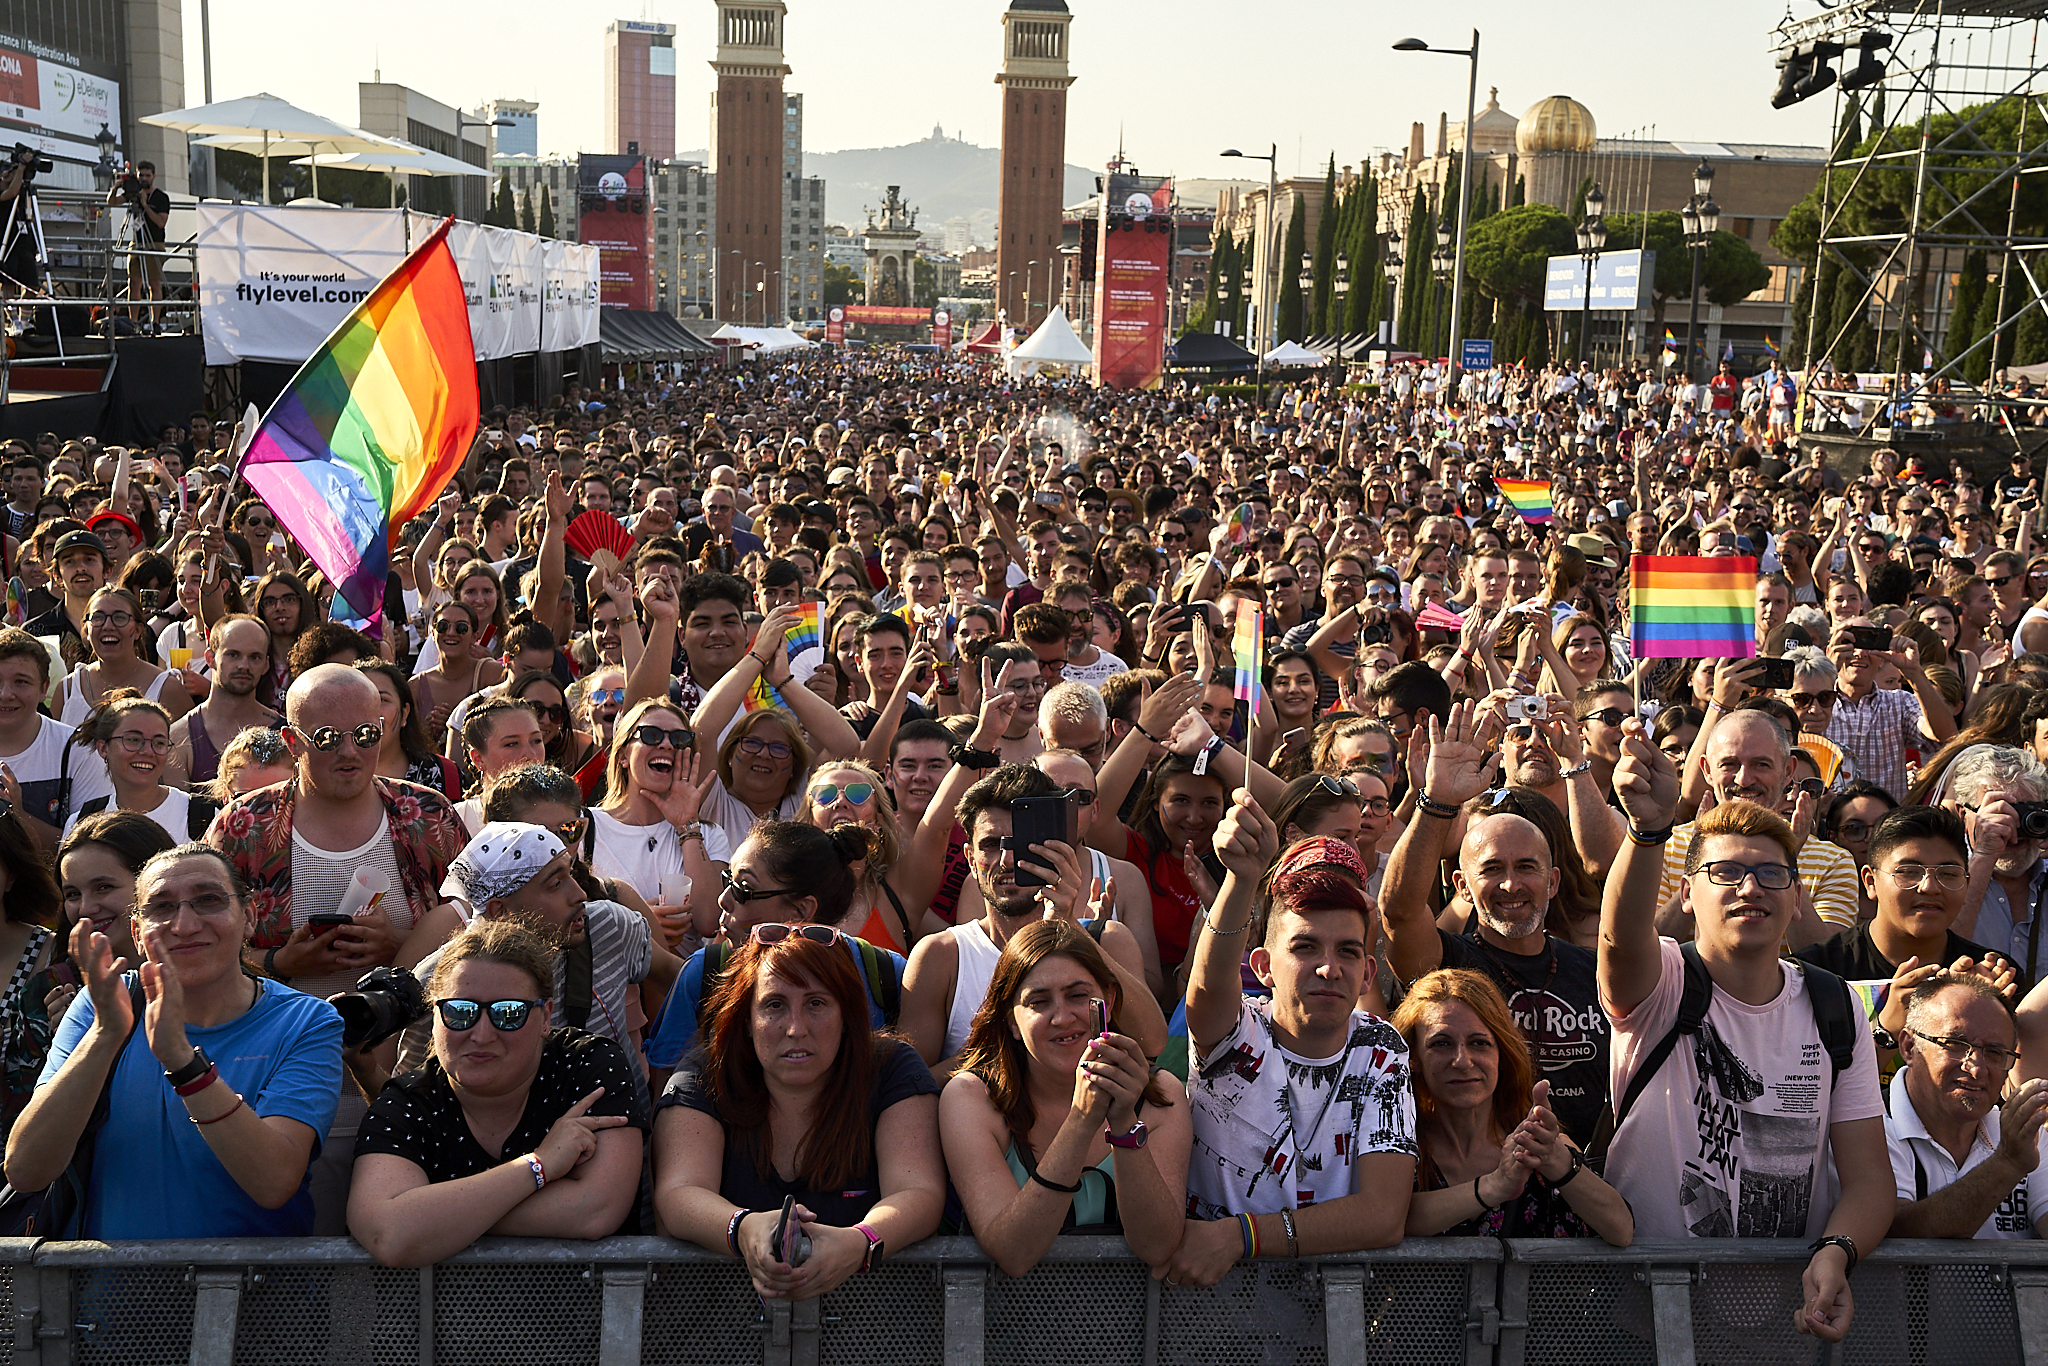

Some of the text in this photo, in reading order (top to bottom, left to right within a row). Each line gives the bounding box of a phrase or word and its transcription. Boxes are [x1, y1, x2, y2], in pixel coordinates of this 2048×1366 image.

[625, 21, 655, 31] Allianz
[28, 40, 65, 60] Registration
[65, 51, 80, 67] Area
[77, 77, 109, 106] eDelivery
[260, 271, 346, 284] It's your world
[236, 283, 369, 305] flylevel.com
[1465, 357, 1489, 366] TAXI
[356, 978, 372, 990] Nikon
[1543, 1005, 1605, 1038] Rock
[1550, 1046, 1591, 1057] CASINO
[1801, 1043, 1821, 1051] UPPER
[1555, 1086, 1586, 1097] CANA
[1693, 1083, 1739, 1131] MAN
[1698, 1109, 1742, 1153] HAT
[1698, 1133, 1739, 1181] TAN
